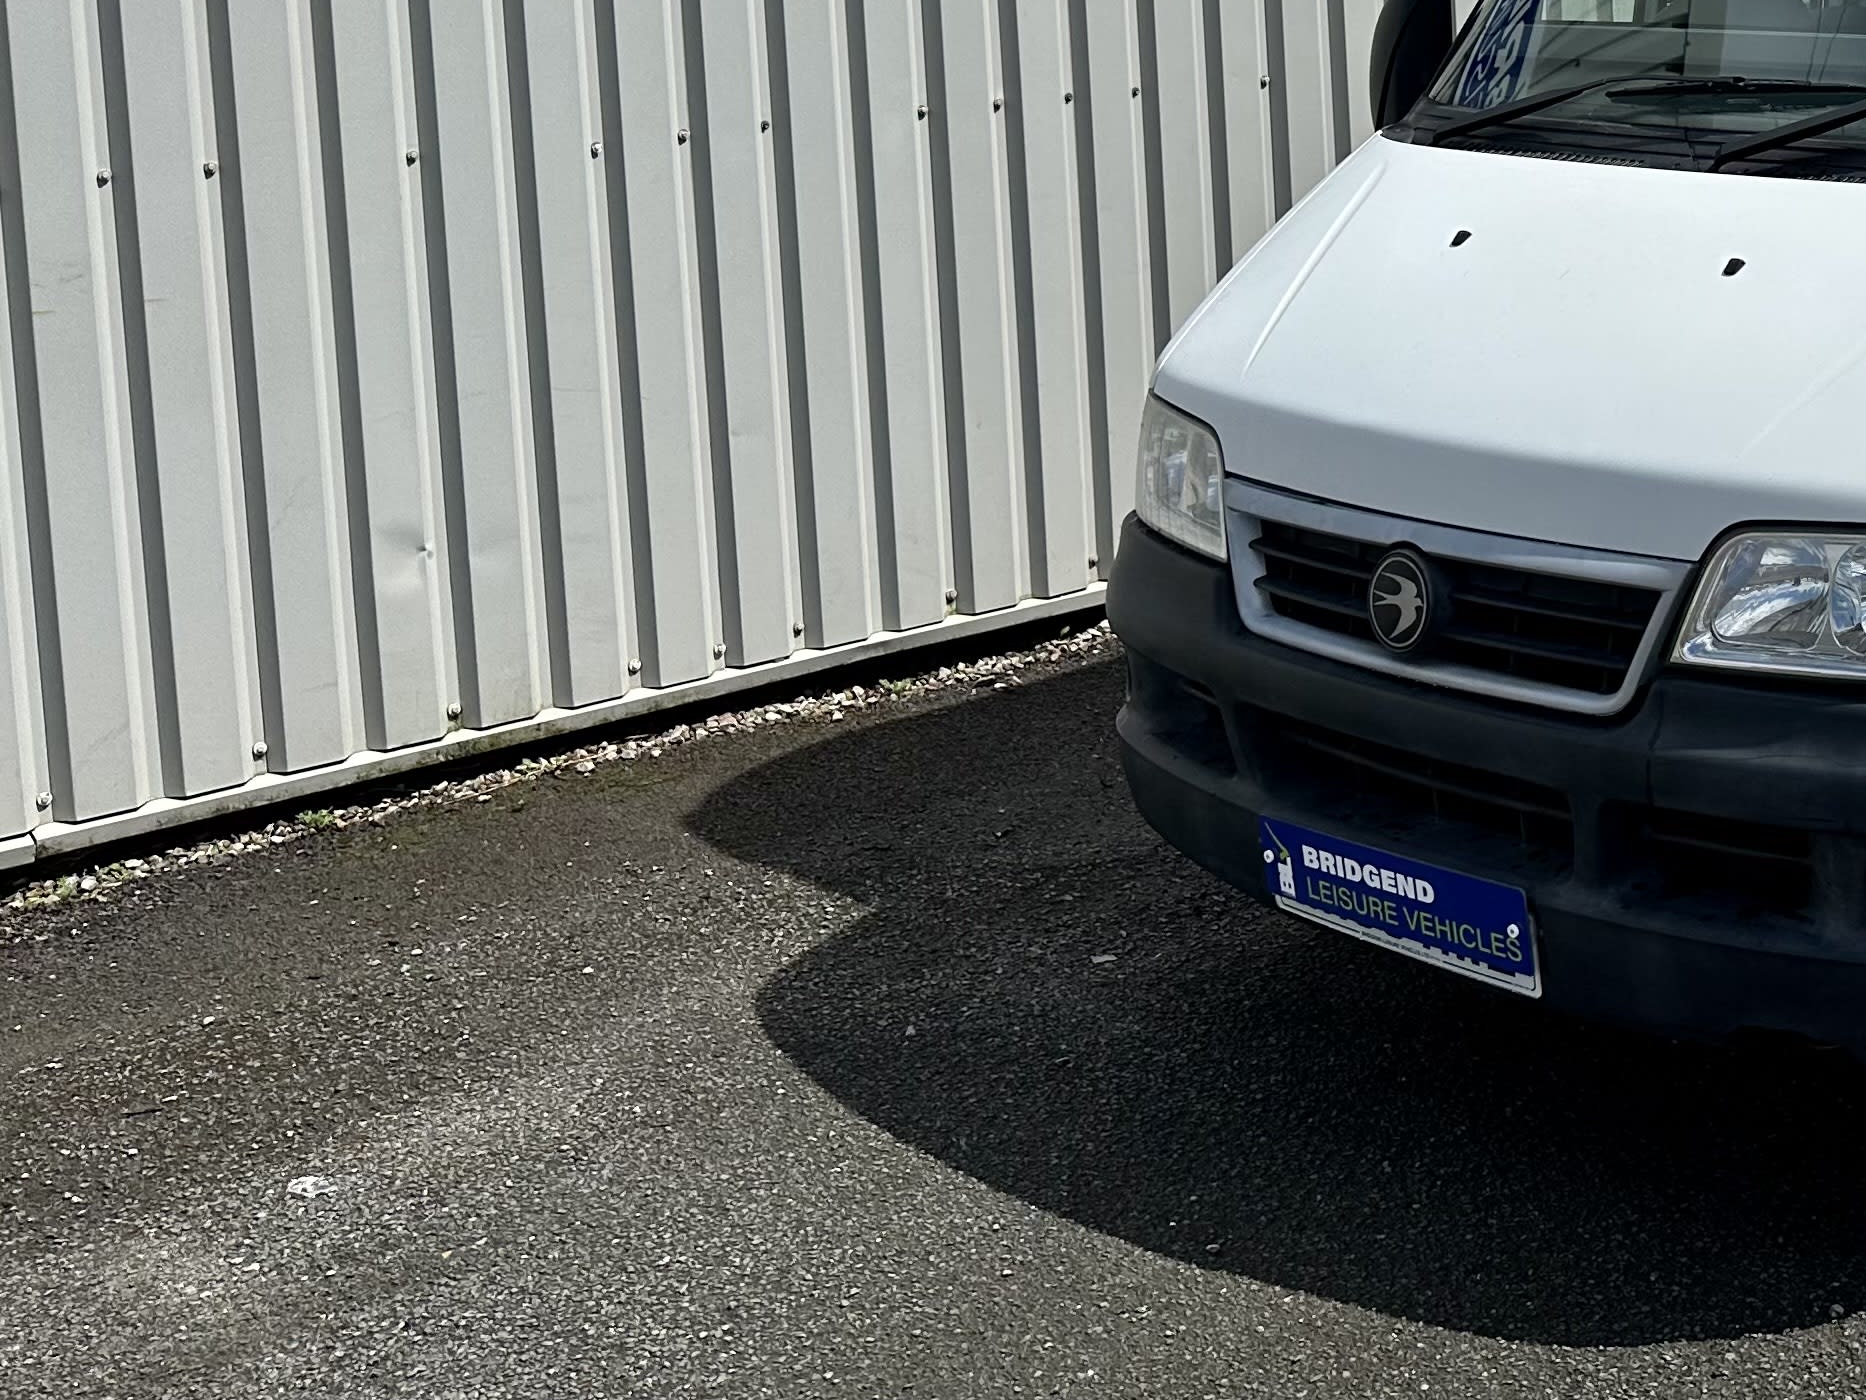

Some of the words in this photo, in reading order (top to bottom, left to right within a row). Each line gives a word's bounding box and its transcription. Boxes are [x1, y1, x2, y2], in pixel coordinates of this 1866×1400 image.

[1301, 843, 1435, 904] BRIDGEND
[1306, 875, 1399, 927] LEISURE
[1402, 905, 1523, 963] VEHICLES
